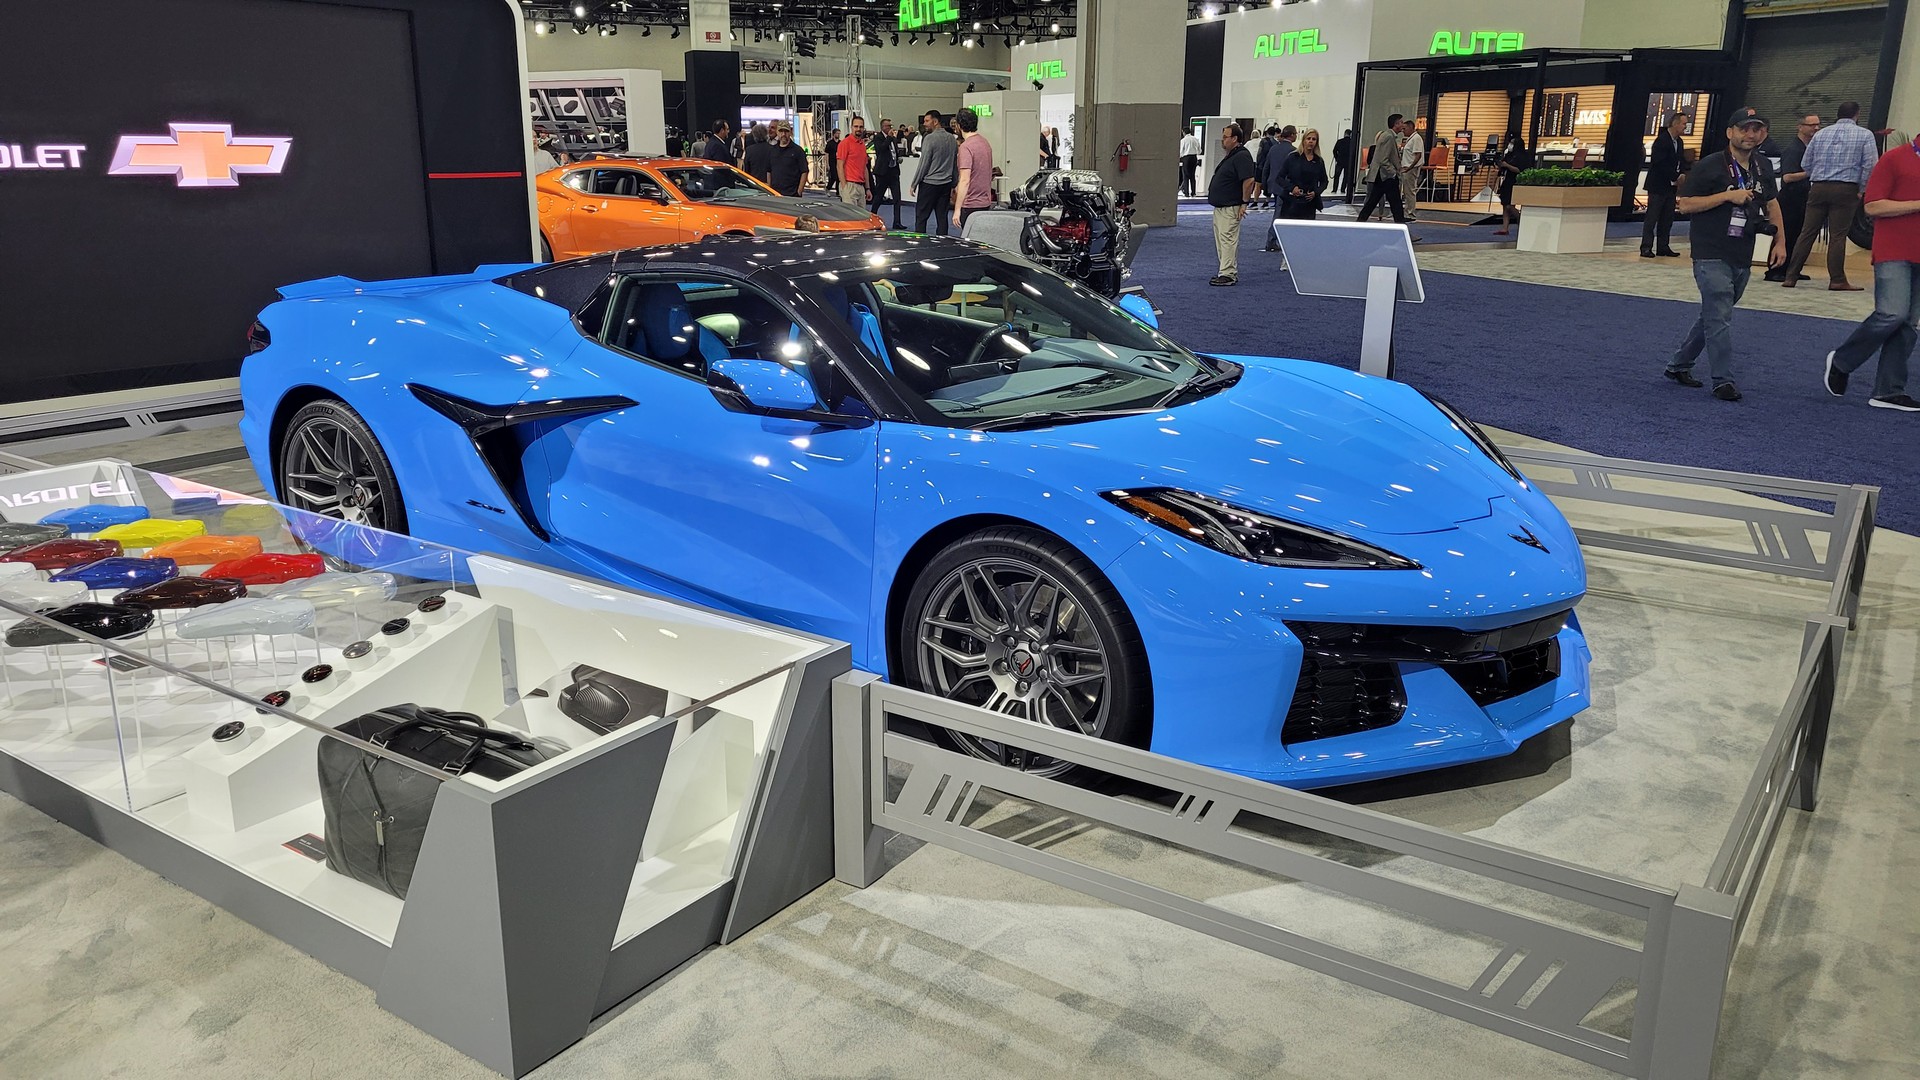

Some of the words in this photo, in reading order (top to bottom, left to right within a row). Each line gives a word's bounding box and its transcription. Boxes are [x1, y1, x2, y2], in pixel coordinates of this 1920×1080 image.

[898, 0, 960, 31] AUTEL
[1253, 28, 1329, 60] AUTEL
[1026, 59, 1068, 81] AUTEL
[1567, 96, 1577, 136] MANUFACTURE
